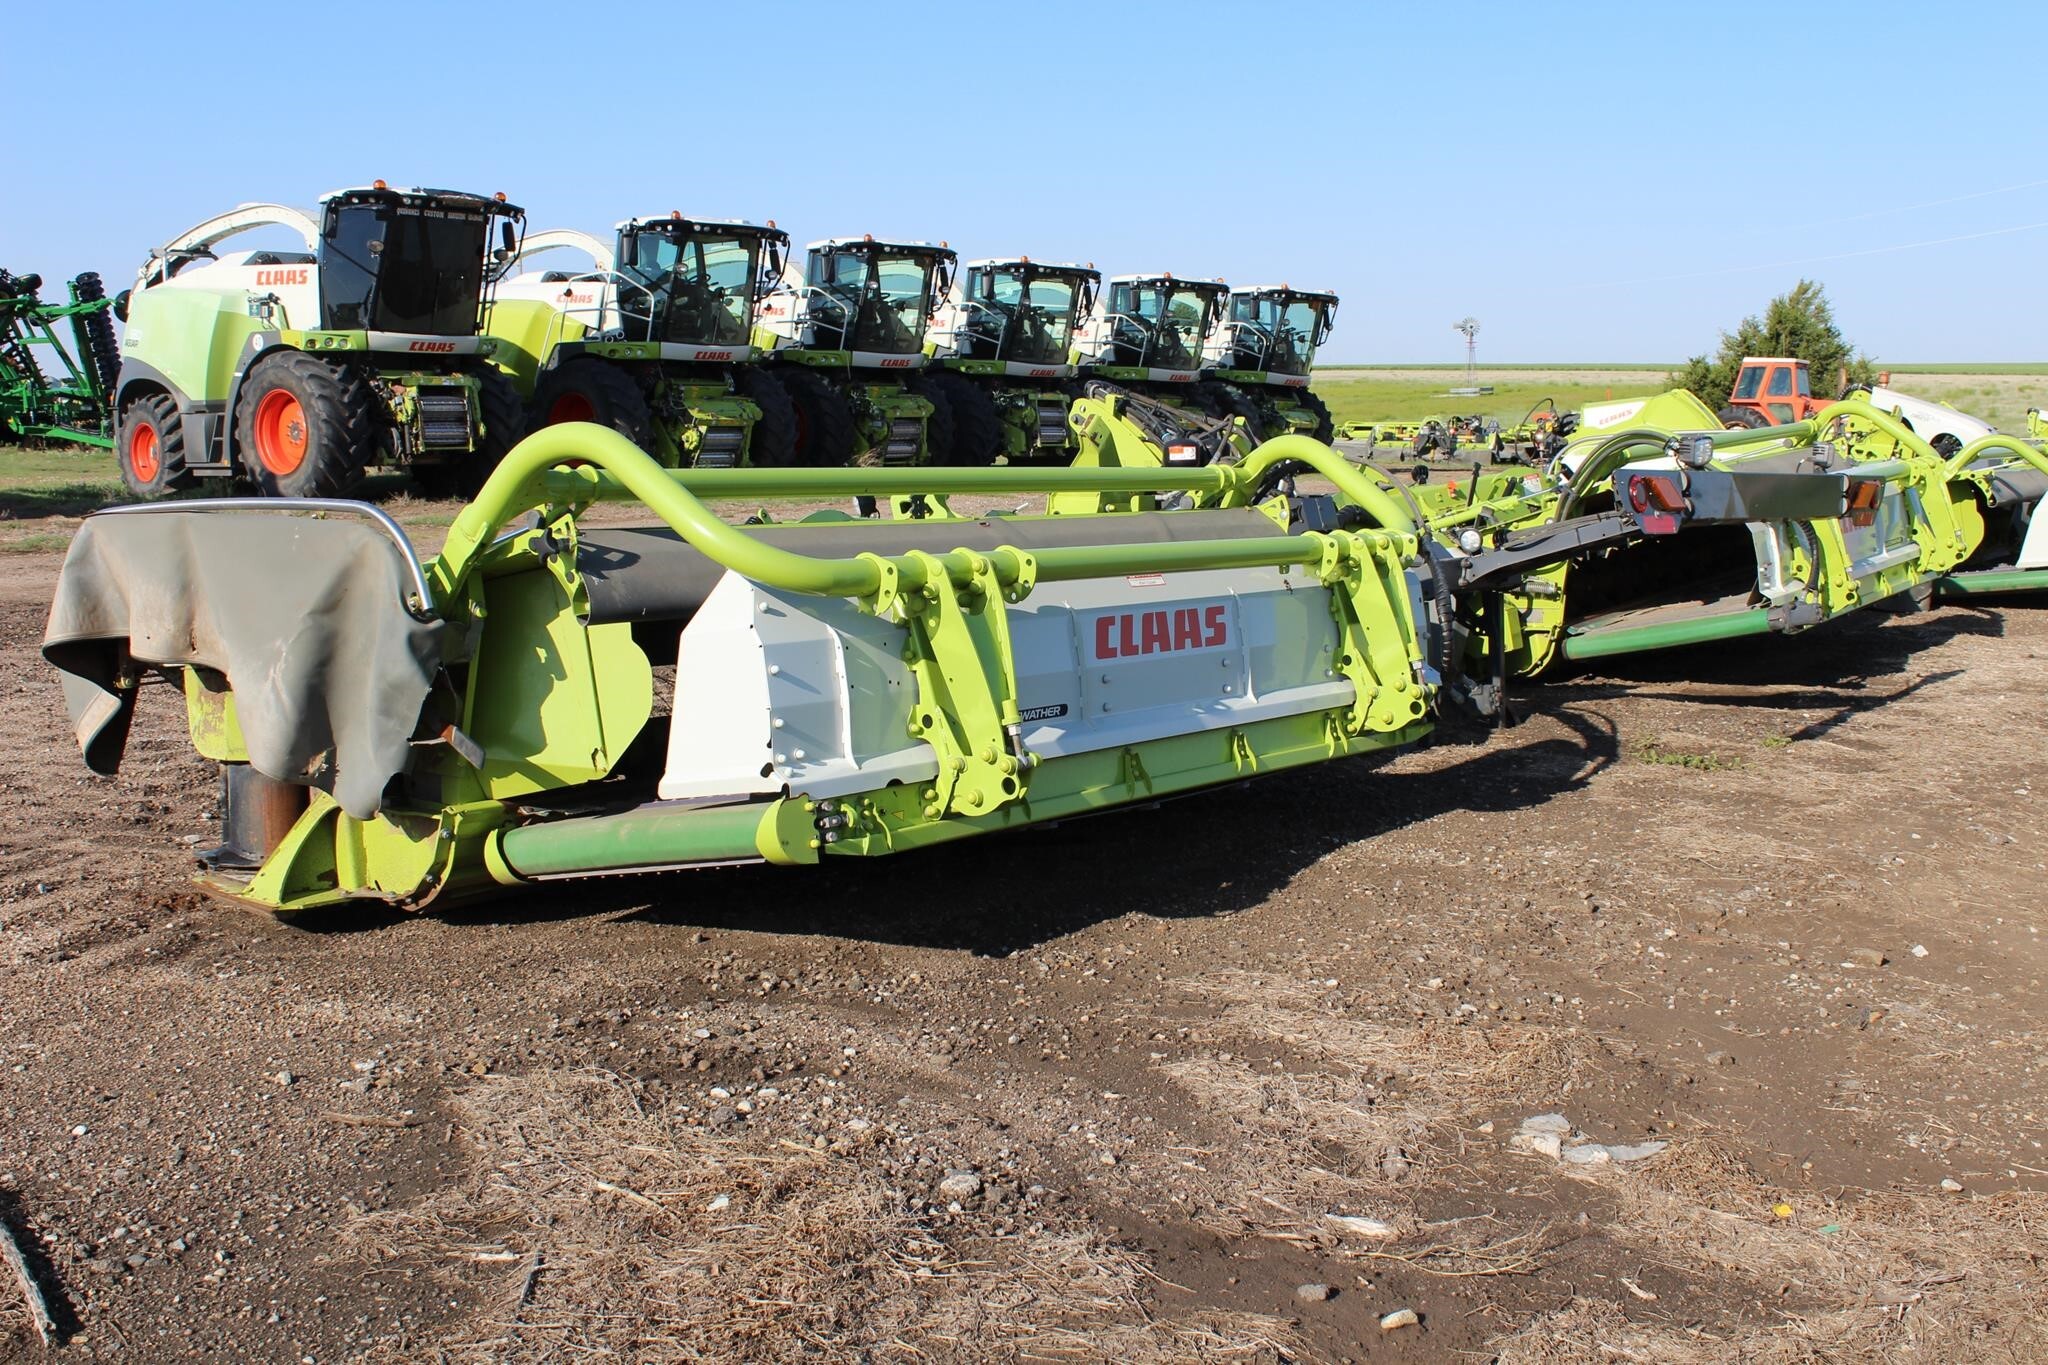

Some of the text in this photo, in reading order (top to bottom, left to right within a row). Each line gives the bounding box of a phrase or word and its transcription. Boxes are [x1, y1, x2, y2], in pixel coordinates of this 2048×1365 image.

[257, 270, 307, 285] CLAAS
[409, 341, 456, 352] CLAAS
[694, 351, 732, 361] CLAAS
[880, 359, 911, 368] CLAAS
[1030, 369, 1057, 377] CLAAS
[1599, 409, 1633, 425] CLAAS
[1096, 606, 1227, 660] CLAAS
[1019, 706, 1061, 721] WATHER
